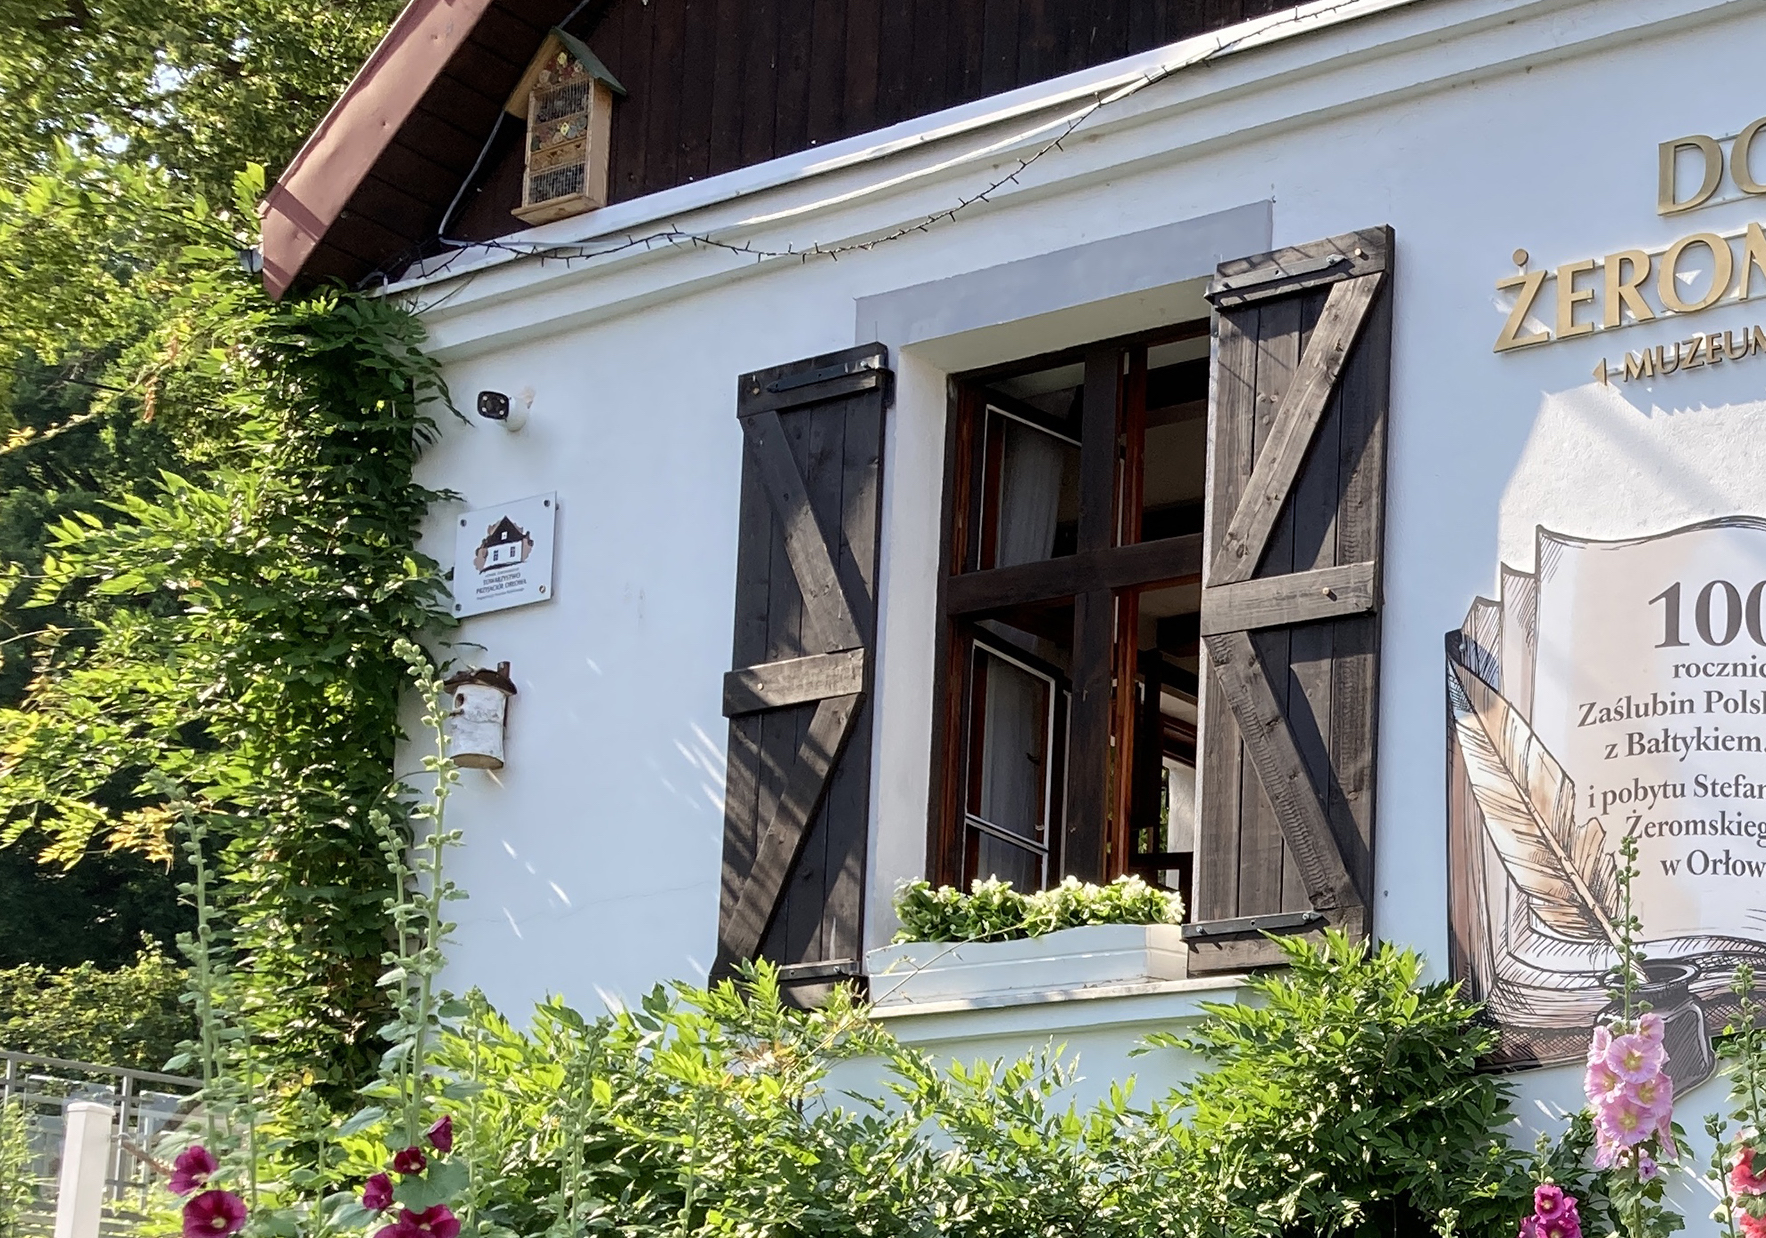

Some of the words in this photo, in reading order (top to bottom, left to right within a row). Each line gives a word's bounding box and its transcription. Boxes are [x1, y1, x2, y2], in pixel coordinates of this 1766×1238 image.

[1578, 691, 1695, 728] Zaślubin
[1604, 743, 1618, 760] z
[1588, 785, 1595, 809] i
[1602, 778, 1686, 816] pobytu
[1660, 858, 1681, 876] w
